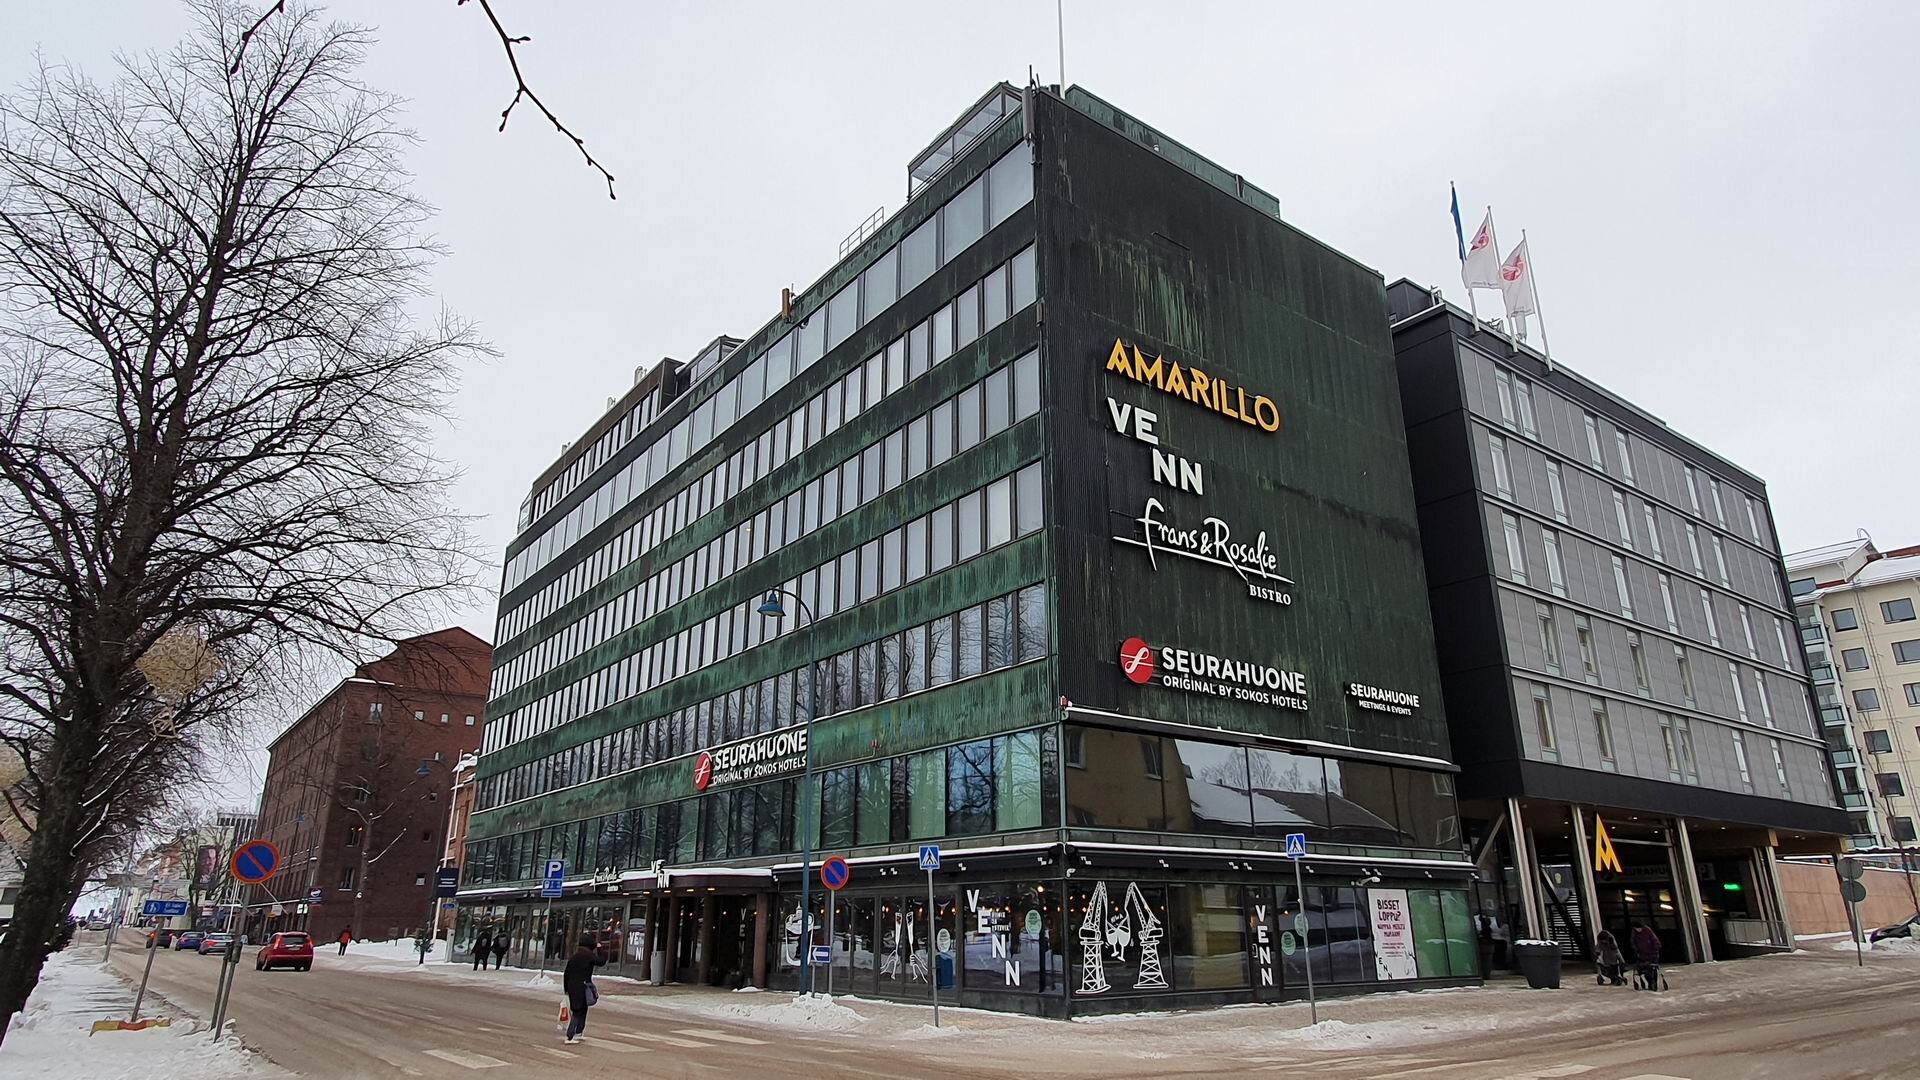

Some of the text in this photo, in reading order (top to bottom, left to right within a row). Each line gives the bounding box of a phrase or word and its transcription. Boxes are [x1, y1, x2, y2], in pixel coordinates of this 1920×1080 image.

[1106, 336, 1280, 432] AMARILLO
[1250, 584, 1292, 605] BISTRO
[1162, 647, 1307, 695] SEURAHUONE
[1163, 675, 1308, 711] ORIGINAL BY SOKOS HOTELS
[1350, 682, 1420, 708] SEURAHUONE
[1359, 699, 1386, 712] MEETINGS
[1391, 705, 1412, 716] EVENTS
[715, 729, 807, 770] SEURAHUONE
[713, 756, 806, 784] ORIGINAL BY SOKOS HOTELS
[548, 861, 562, 878] P
[1377, 899, 1400, 910] BISSET
[1255, 904, 1273, 986] VENN
